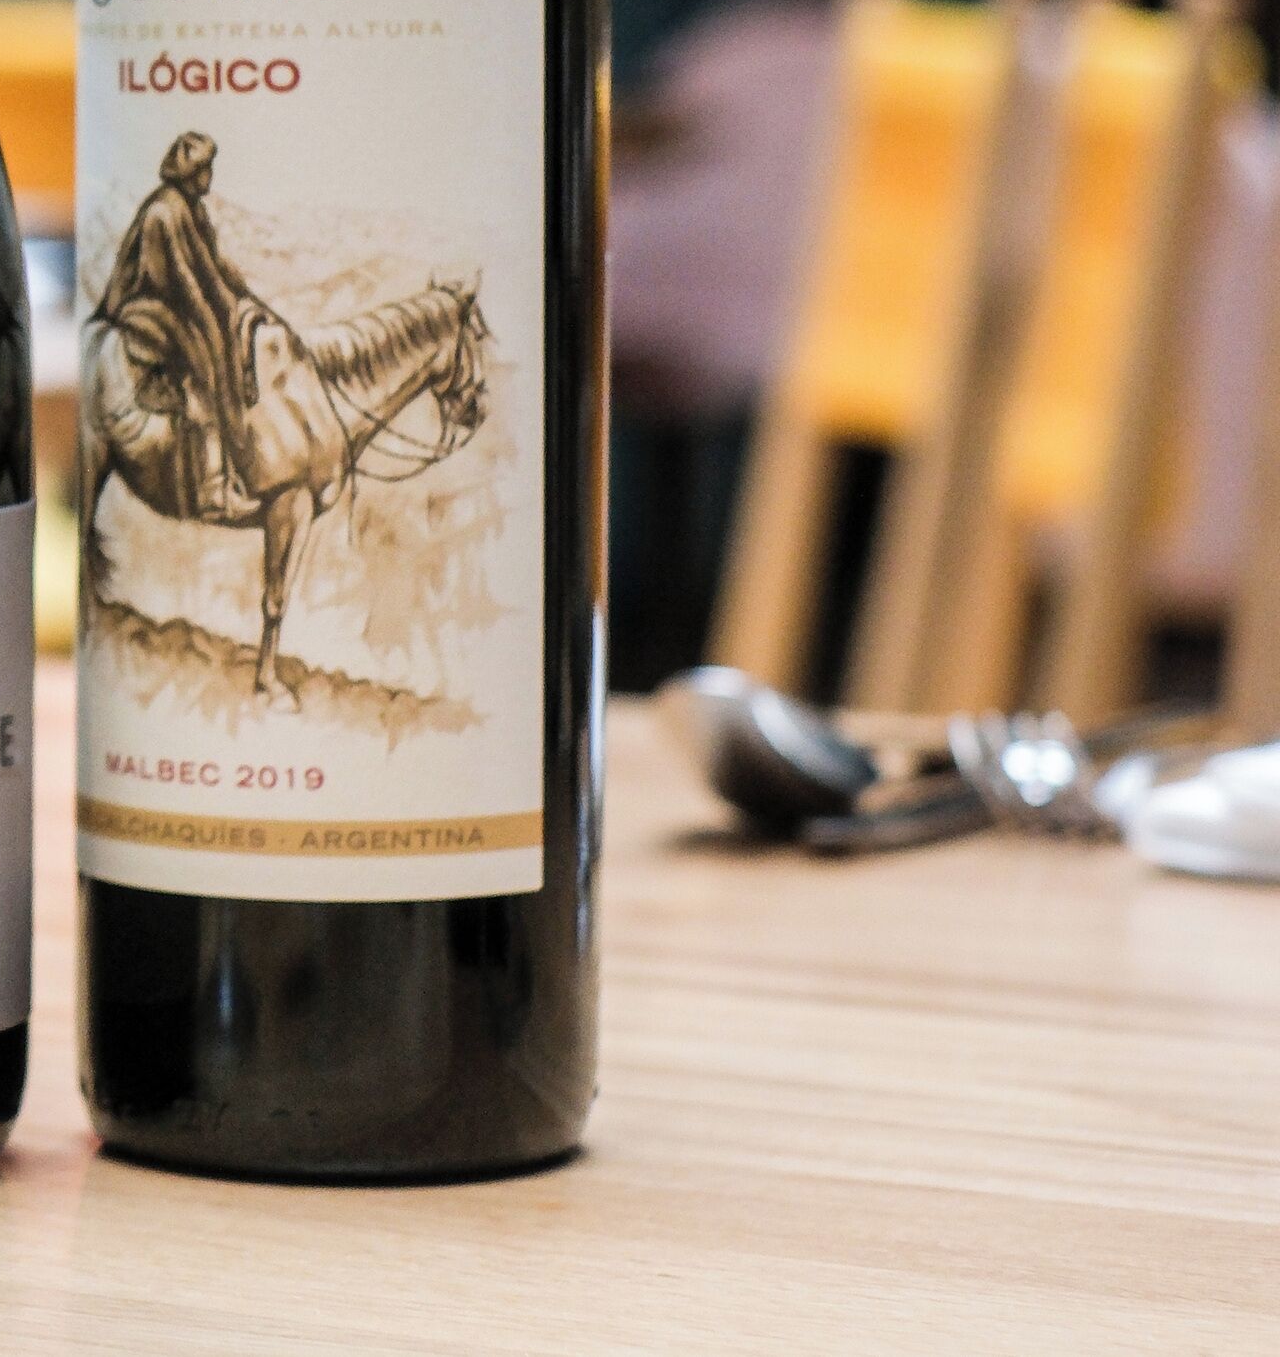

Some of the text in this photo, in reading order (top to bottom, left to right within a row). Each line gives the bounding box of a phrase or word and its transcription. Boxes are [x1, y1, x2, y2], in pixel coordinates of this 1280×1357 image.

[325, 18, 446, 39] ALTURA
[117, 50, 302, 95] ILÓGICO
[104, 750, 326, 792] MALBEC 2019
[299, 823, 485, 852] ARGENTINA
